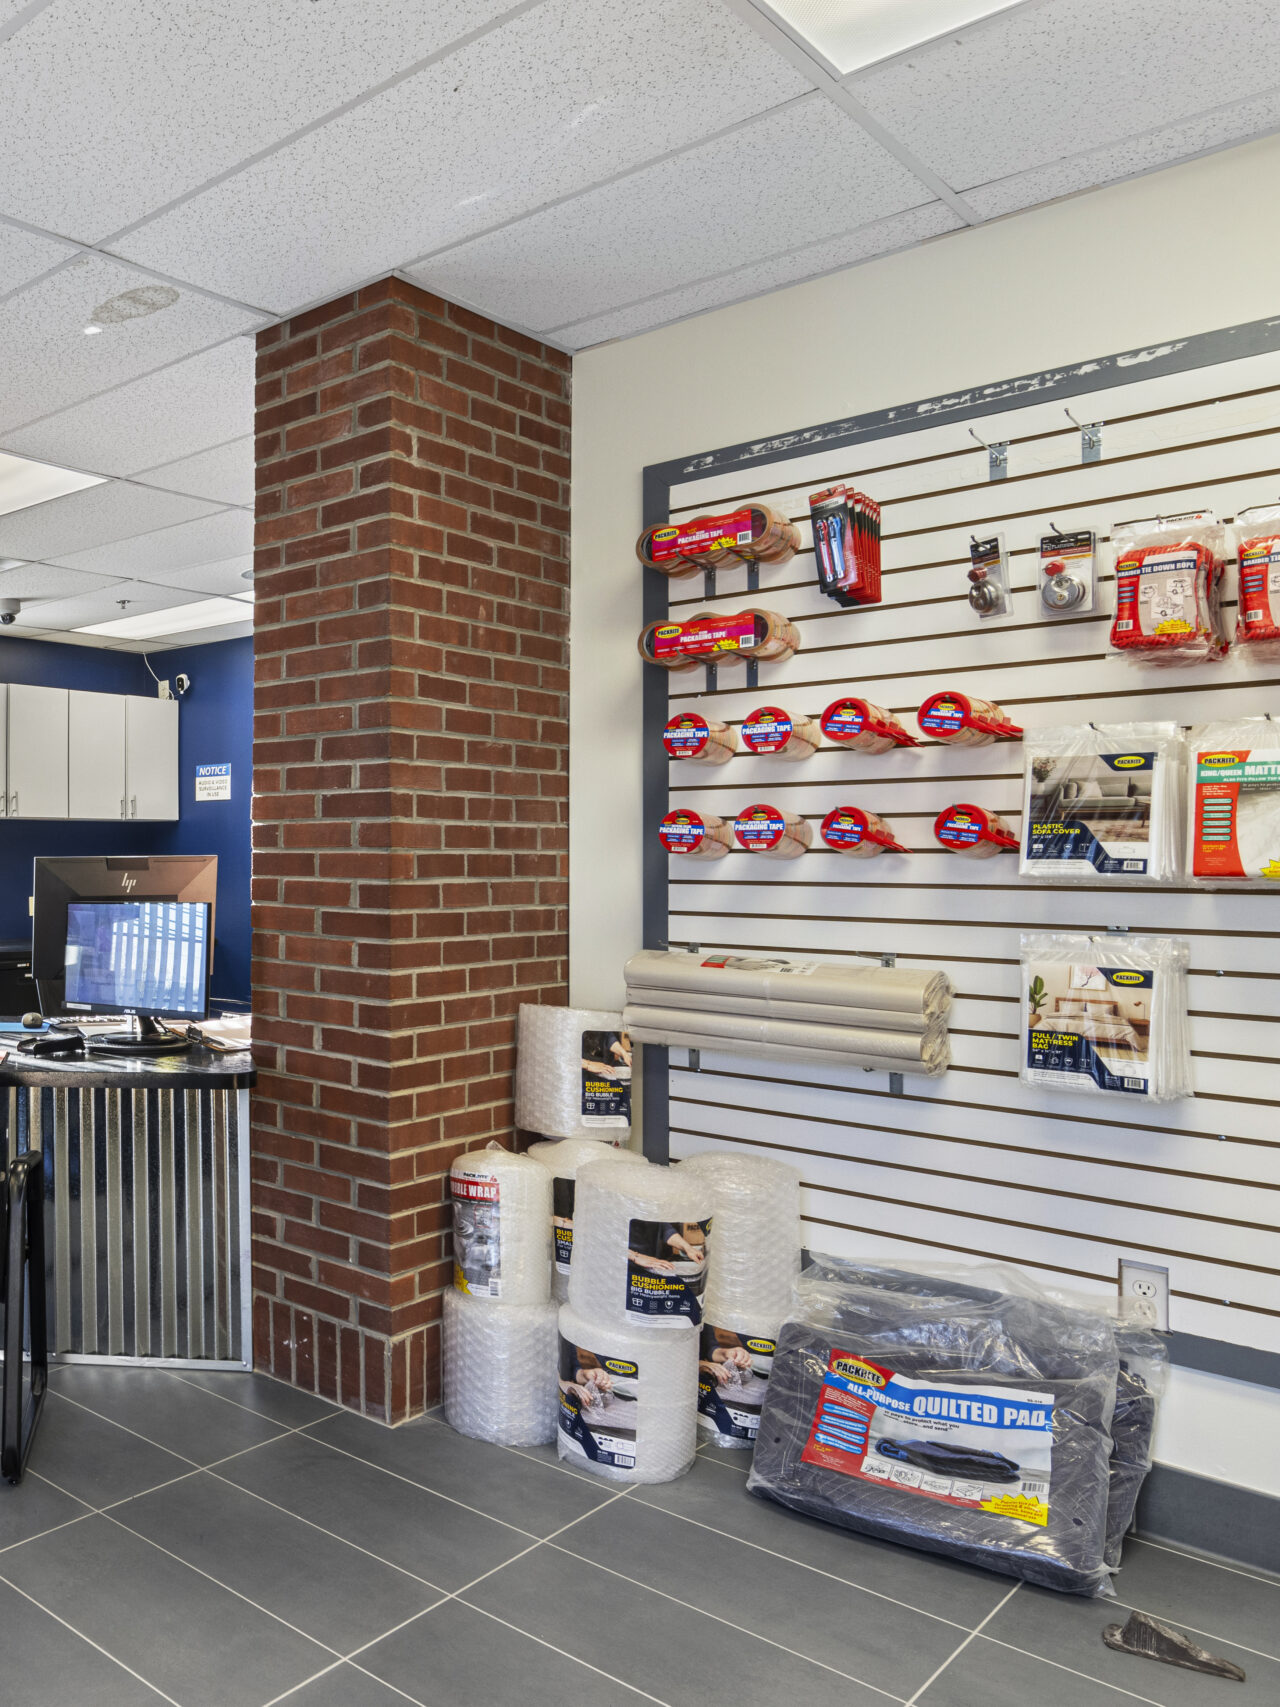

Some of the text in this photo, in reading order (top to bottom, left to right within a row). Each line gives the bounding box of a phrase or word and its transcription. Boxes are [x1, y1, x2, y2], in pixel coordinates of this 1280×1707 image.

[678, 532, 710, 544] PACKAGING
[710, 529, 724, 540] TAPE
[1244, 558, 1269, 566] BRAIDED
[657, 628, 680, 636] PACKRITE
[680, 632, 712, 643] PACKAGING
[712, 630, 727, 640] TAPE
[742, 726, 775, 735] PACKAGING
[199, 766, 227, 776] NOTICE
[122, 872, 137, 893] hp
[1032, 1038, 1073, 1046] MATTRESS
[468, 1184, 497, 1198] WRAP
[632, 1275, 666, 1284] BUBBLE
[632, 1281, 685, 1290] CUSHIONING
[750, 1342, 772, 1350] PACKRITE
[837, 1361, 881, 1384] PACKRITE
[847, 1383, 910, 1411] ALL-PURPOSE
[913, 1396, 998, 1424] QUILTED
[1004, 1407, 1045, 1426] PAD
